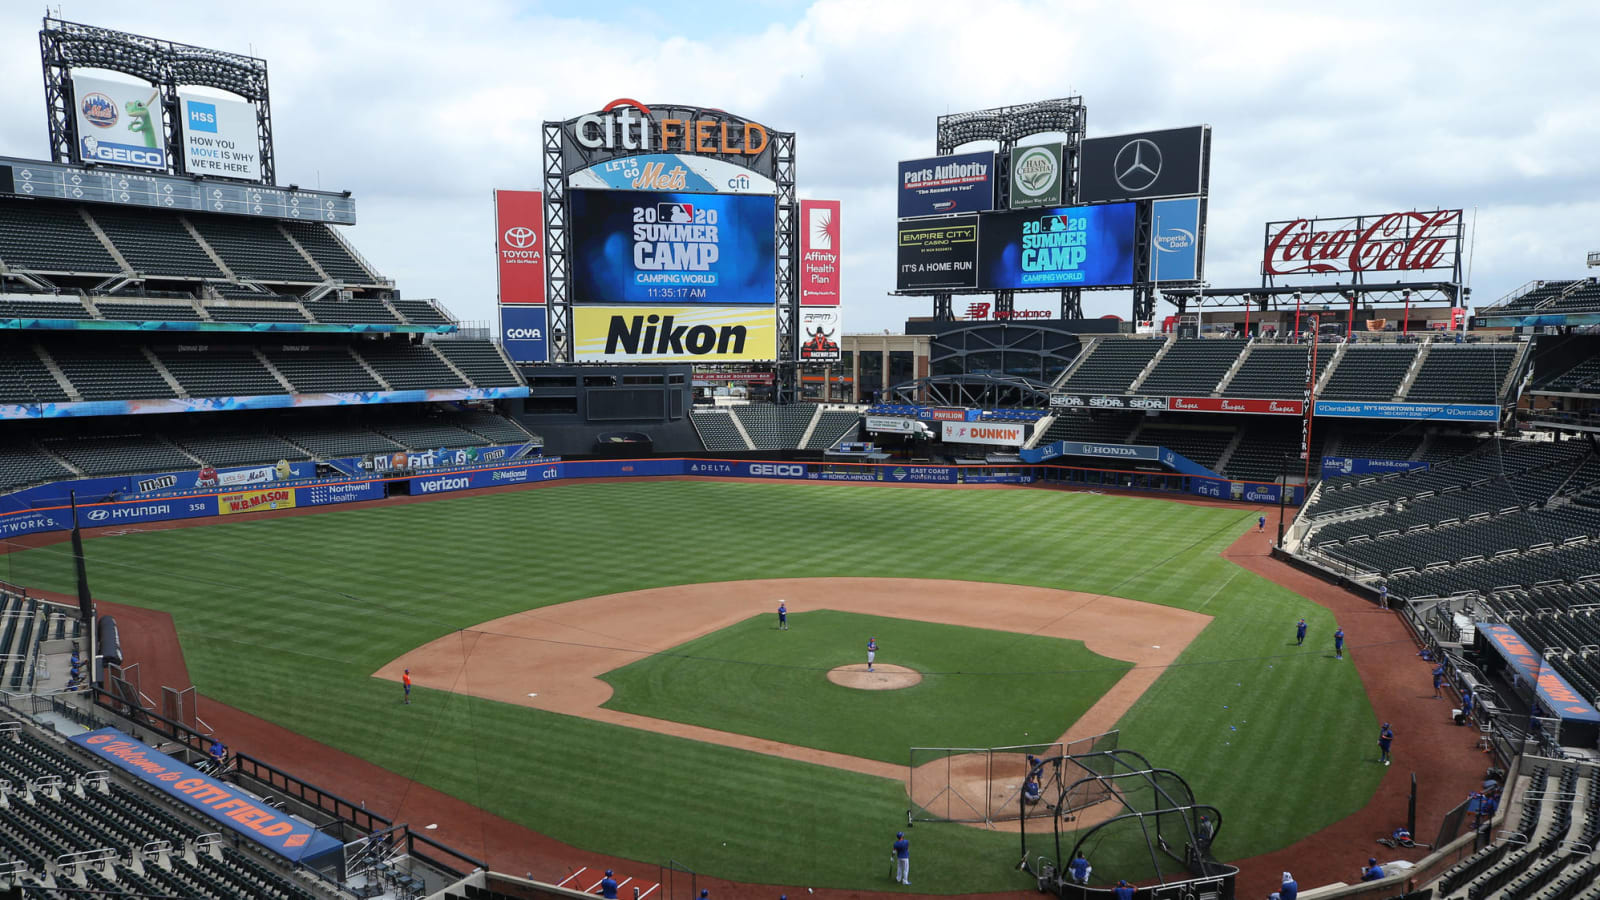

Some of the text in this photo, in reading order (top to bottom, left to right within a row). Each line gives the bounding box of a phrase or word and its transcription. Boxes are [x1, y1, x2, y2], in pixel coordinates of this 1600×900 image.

[191, 111, 214, 123] HSS
[576, 108, 768, 154] citi FIELD
[190, 136, 234, 150] HOW YOU
[97, 146, 161, 165] GEICO
[191, 148, 254, 162] MOVE IS WHY
[192, 159, 252, 173] WE'RE HERE.
[605, 158, 638, 172] LET'S
[1026, 160, 1046, 168] HAIN
[624, 168, 640, 178] GO
[632, 162, 686, 190] Mets
[904, 162, 987, 184] Parts Authority
[728, 177, 750, 190] citi
[633, 207, 718, 224] 20 20
[1023, 218, 1086, 234] 20 20
[634, 224, 718, 242] SUMMER
[904, 230, 971, 242] EMPIRE CITY
[1022, 232, 1086, 248] SUMMER
[1170, 240, 1189, 248] Dade
[502, 250, 540, 258] TOYOTA
[634, 242, 719, 270] CAMP
[805, 252, 836, 264] Affinity
[1022, 246, 1086, 272] CAMP
[806, 264, 834, 273] Health
[902, 261, 972, 272] IT'S A HOME RUN
[636, 273, 716, 284] CAMPING WORLD
[811, 274, 830, 284] Plan
[1024, 272, 1082, 282] CAMPING WORLD
[648, 288, 706, 298] 11:35:17 AM
[1012, 308, 1052, 318] balance
[507, 328, 542, 339] GOYA
[604, 314, 747, 355] Nikon
[1324, 405, 1361, 413] Dental365
[1452, 408, 1494, 416] Dental365
[970, 428, 1020, 440] DUNKIN'
[1093, 446, 1138, 456] HONDA
[500, 469, 528, 478] National
[542, 468, 558, 478] citi
[701, 464, 731, 472] DELTA
[750, 464, 802, 476] GEICO
[330, 482, 370, 493] Northwell
[420, 476, 470, 492] verizon
[330, 492, 355, 502] Health
[1247, 492, 1276, 501] Corona
[112, 504, 170, 518] HYUNDAI
[188, 504, 206, 512] 358
[0, 518, 60, 534] TWORKS.
[102, 741, 294, 836] Welcome to CITI FIELD
